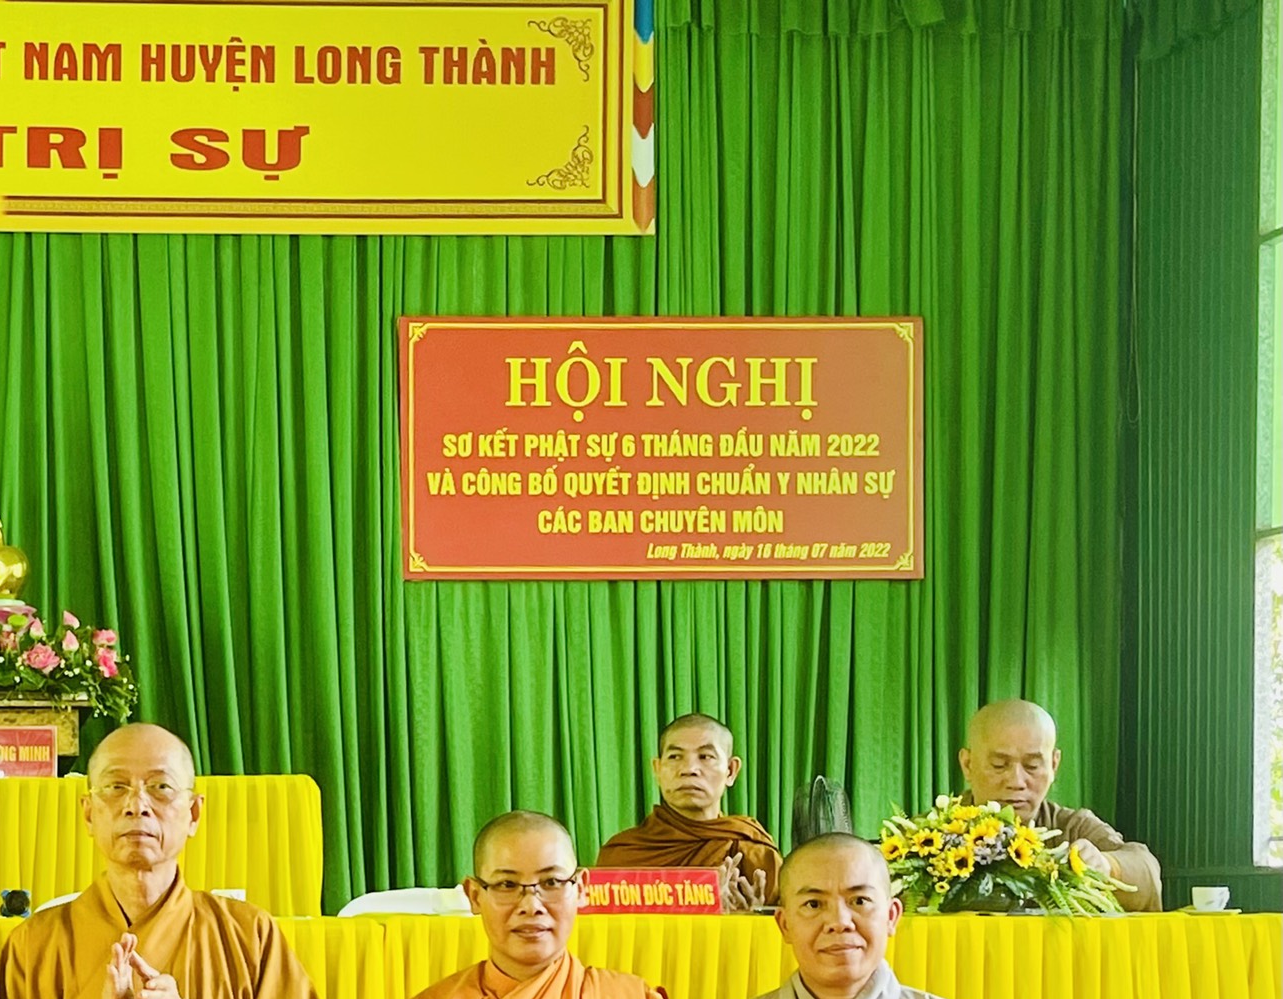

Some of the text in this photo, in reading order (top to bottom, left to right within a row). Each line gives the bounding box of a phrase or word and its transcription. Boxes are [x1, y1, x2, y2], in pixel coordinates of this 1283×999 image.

[24, 42, 119, 83] NAM
[140, 37, 276, 92] HUYỆN
[296, 45, 403, 86] LONG
[419, 39, 556, 86] THÀNH
[169, 125, 311, 181] SỰ
[505, 341, 818, 422] HỘI NGHỊ
[443, 427, 880, 462] SƠ KẾT PHẬT SỰ 6 THÁNG ĐẦU NĂM 2022
[427, 464, 896, 500] VÀ CÔNG BỐ QUYẾT ĐỊNH CHUẨN Y NHÂN SỰ
[538, 506, 784, 533] CÁC BAN CHUYÊN MÔN
[646, 543, 677, 560] Long
[680, 543, 720, 560] Thành,
[722, 543, 754, 560] ngày
[774, 543, 809, 560] tháng
[811, 543, 827, 559] 07
[829, 543, 856, 559] năm
[858, 543, 891, 559] 2022
[18, 746, 50, 762] MINH
[611, 880, 642, 906] TÔN
[642, 879, 674, 906] ĐỨC
[674, 879, 715, 906] TĂNG
